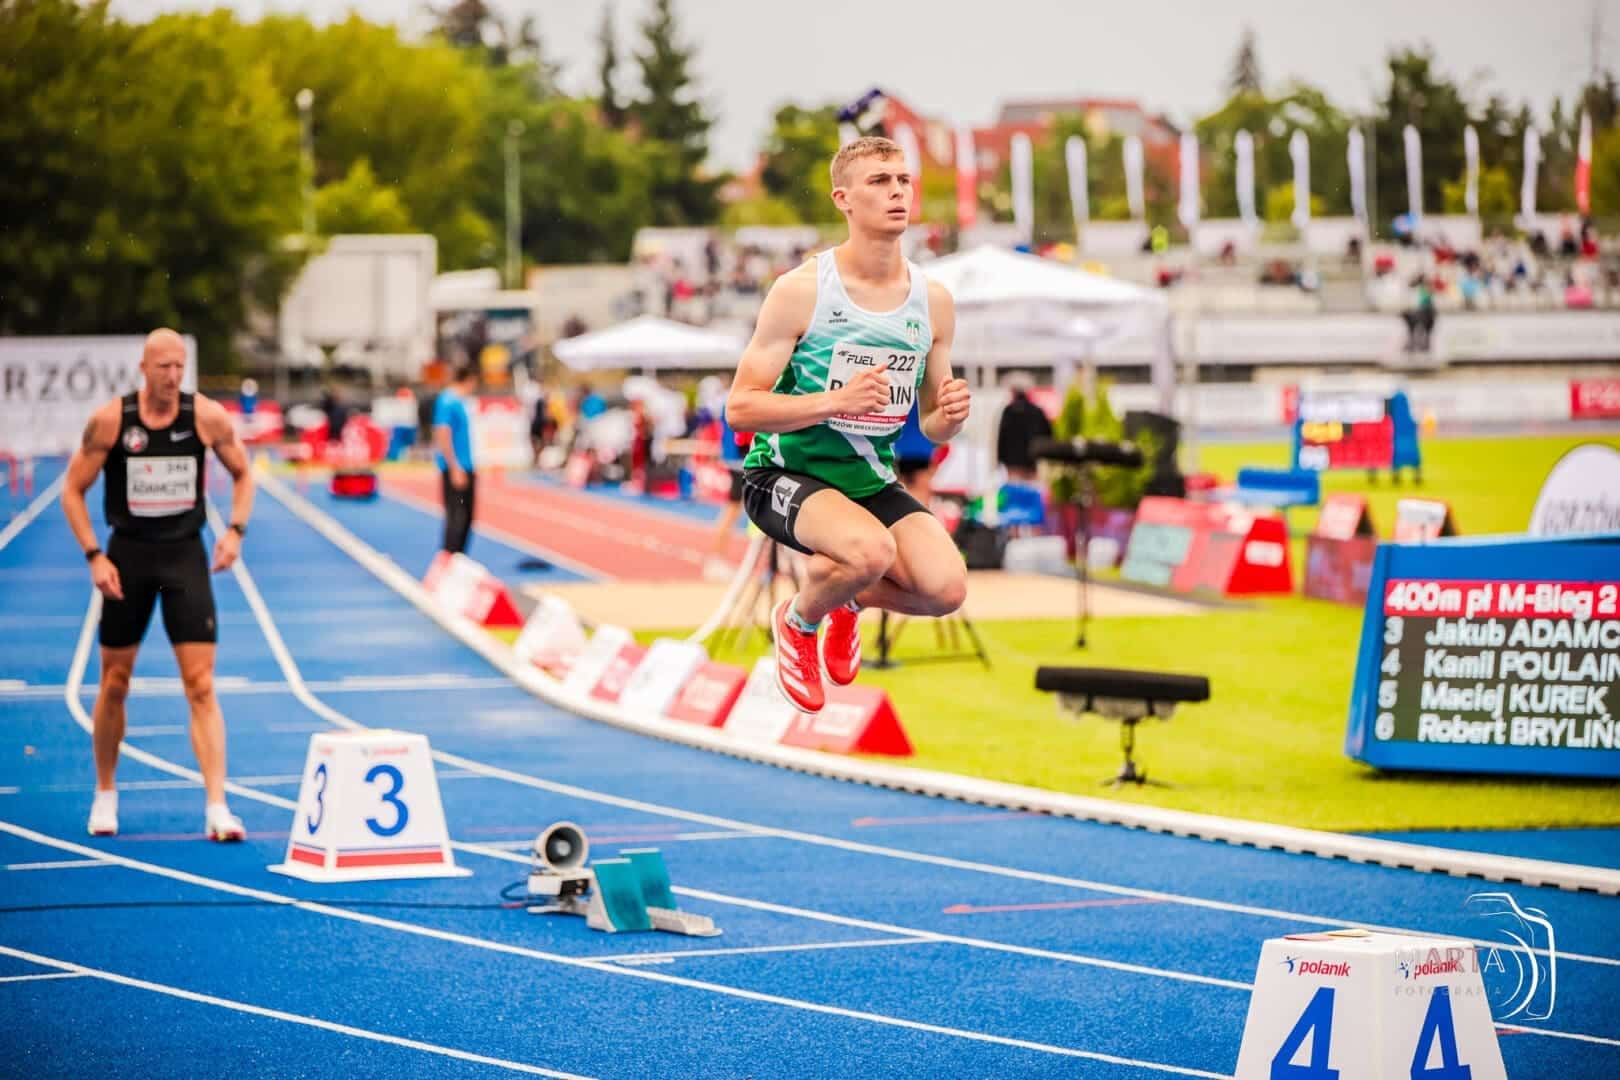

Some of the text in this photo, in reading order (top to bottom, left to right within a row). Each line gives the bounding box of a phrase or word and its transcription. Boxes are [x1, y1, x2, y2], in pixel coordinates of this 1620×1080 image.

[847, 354, 877, 367] FUEL
[887, 354, 916, 372] 222
[830, 379, 912, 405] PAIN
[774, 484, 793, 508] 4
[1386, 582, 1462, 612] 400m
[1497, 583, 1594, 621] M-Bieg
[1597, 584, 1618, 614] 2
[1383, 616, 1404, 645] 3
[1425, 617, 1507, 647] Jakub
[1380, 647, 1402, 677] 4
[1423, 649, 1496, 679] Kamil
[1377, 679, 1609, 719] 5 Maciej KUREK
[1374, 712, 1395, 741] 6
[1417, 713, 1507, 745] Robert
[307, 762, 327, 835] 3
[364, 764, 409, 838] 3
[1298, 959, 1351, 977] polanik
[1270, 986, 1340, 1080] 4
[1410, 985, 1473, 1080] 4
